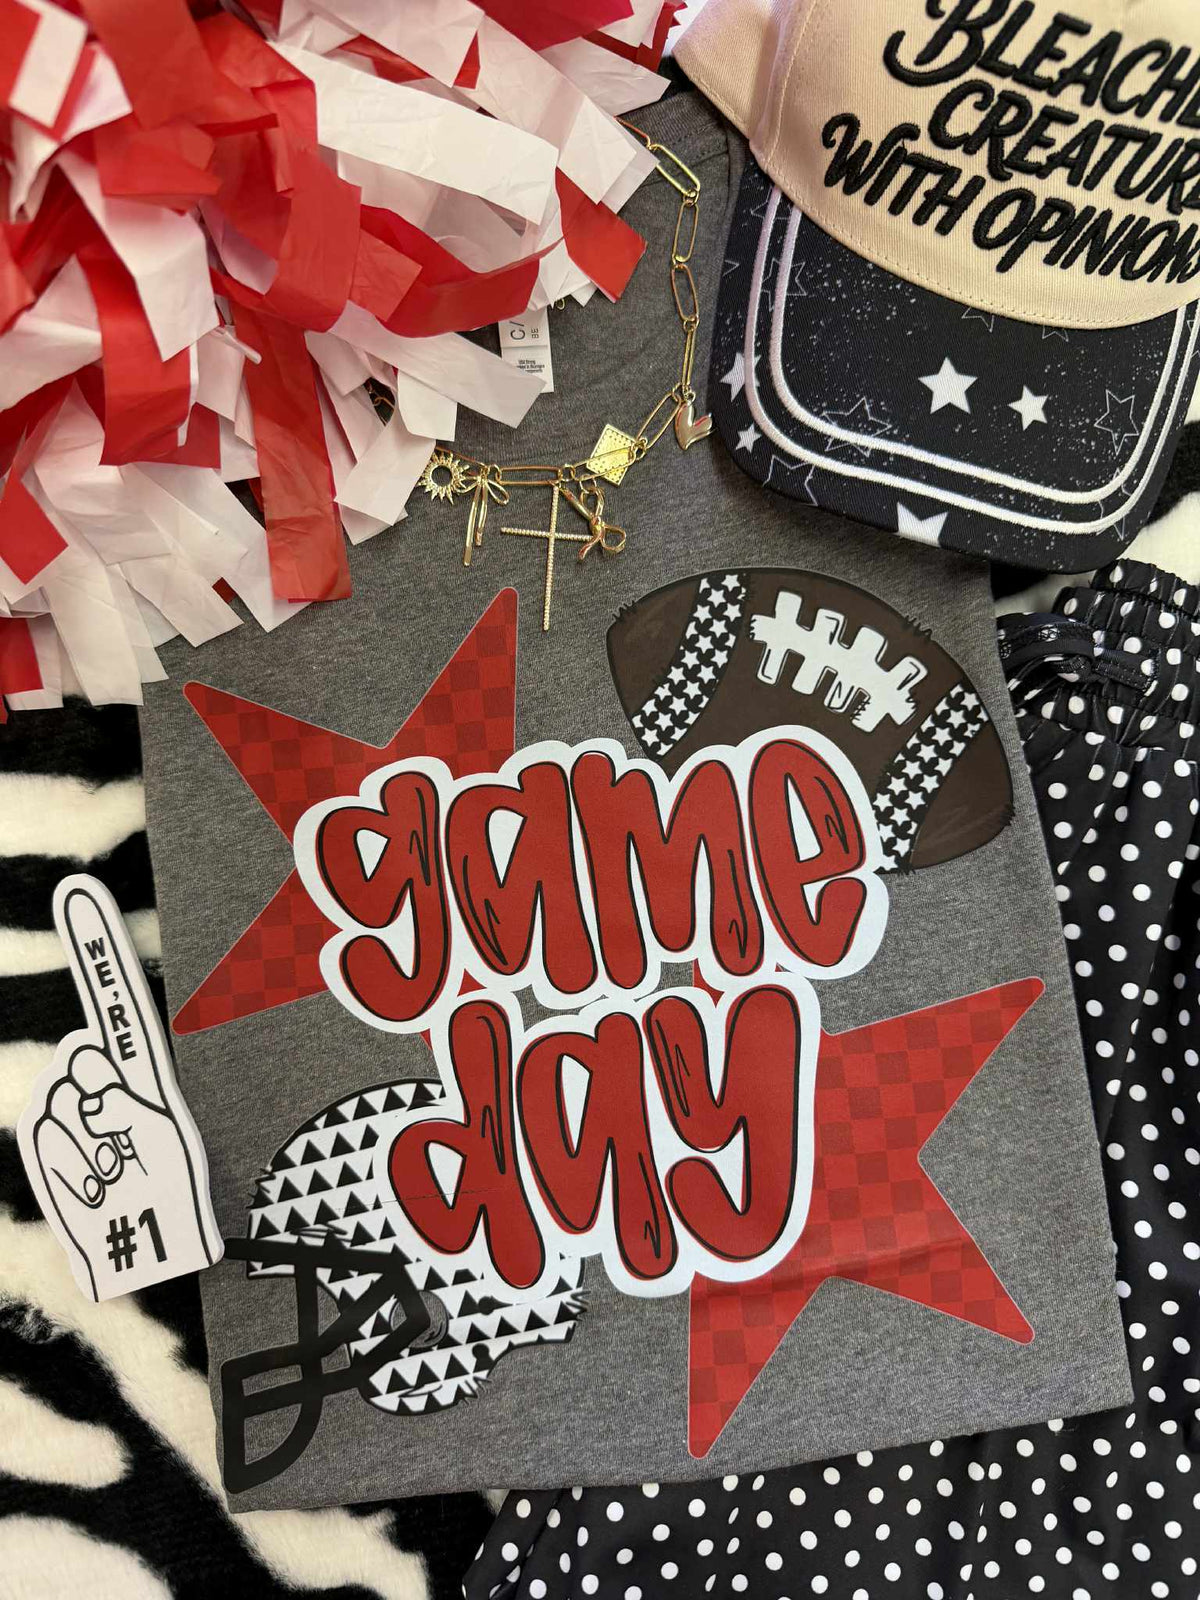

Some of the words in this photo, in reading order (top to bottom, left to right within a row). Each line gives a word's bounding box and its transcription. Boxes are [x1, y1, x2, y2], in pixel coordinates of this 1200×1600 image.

[821, 112, 986, 236] WITH
[972, 187, 1200, 284] OPINION
[316, 739, 867, 1023] game
[105, 1207, 168, 1273] #1
[387, 984, 802, 1289] day
